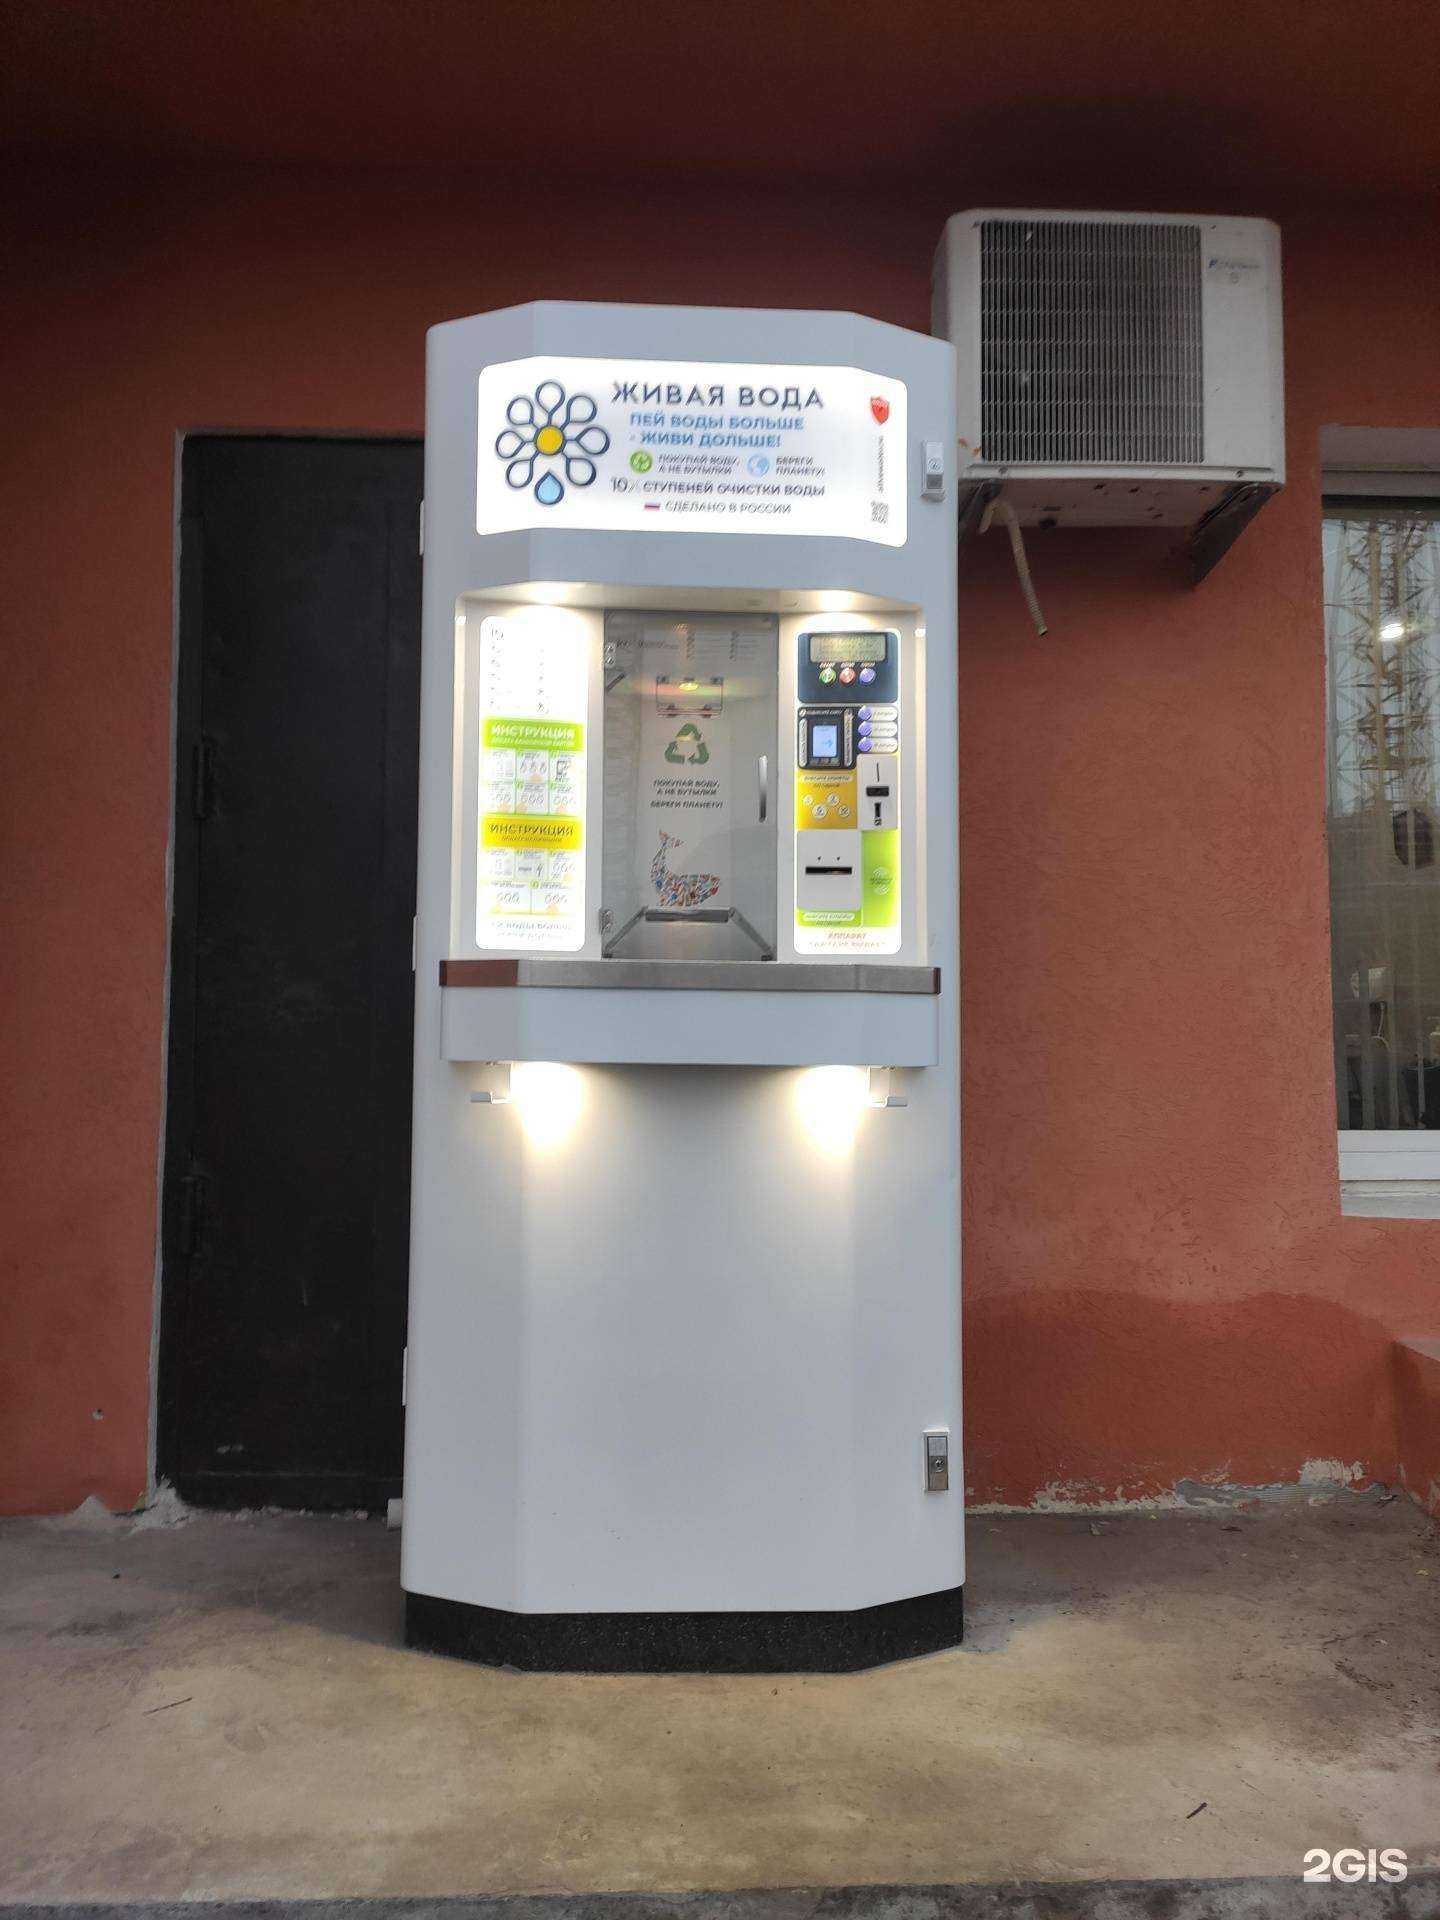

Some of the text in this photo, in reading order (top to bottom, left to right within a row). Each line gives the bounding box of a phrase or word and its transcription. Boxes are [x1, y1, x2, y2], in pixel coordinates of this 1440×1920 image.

[612, 381, 825, 411] ЖИВАЯ ВОДА
[630, 410, 805, 430] ПЕЙ ВОДЫ БОЛЬШЕ
[641, 431, 694, 446] ЖИВИ
[699, 433, 782, 448] ДОЛЬШЕ!
[658, 454, 708, 466] ПОКУПАЙ
[776, 456, 813, 466] БЕРЕГИ
[668, 465, 681, 474] НЕ
[683, 466, 733, 475] БУТЫЛКИ
[643, 480, 714, 494] СТУПЕНЕЙ
[716, 483, 781, 495] ОЧИСТКИ
[784, 484, 826, 498] ВОДЫ
[664, 501, 792, 514] СДЕЛАНО В РОССИИ
[491, 724, 575, 739] ИНСТРУКЦИЯ
[489, 822, 574, 837] ИНСТРУКЦИЯ
